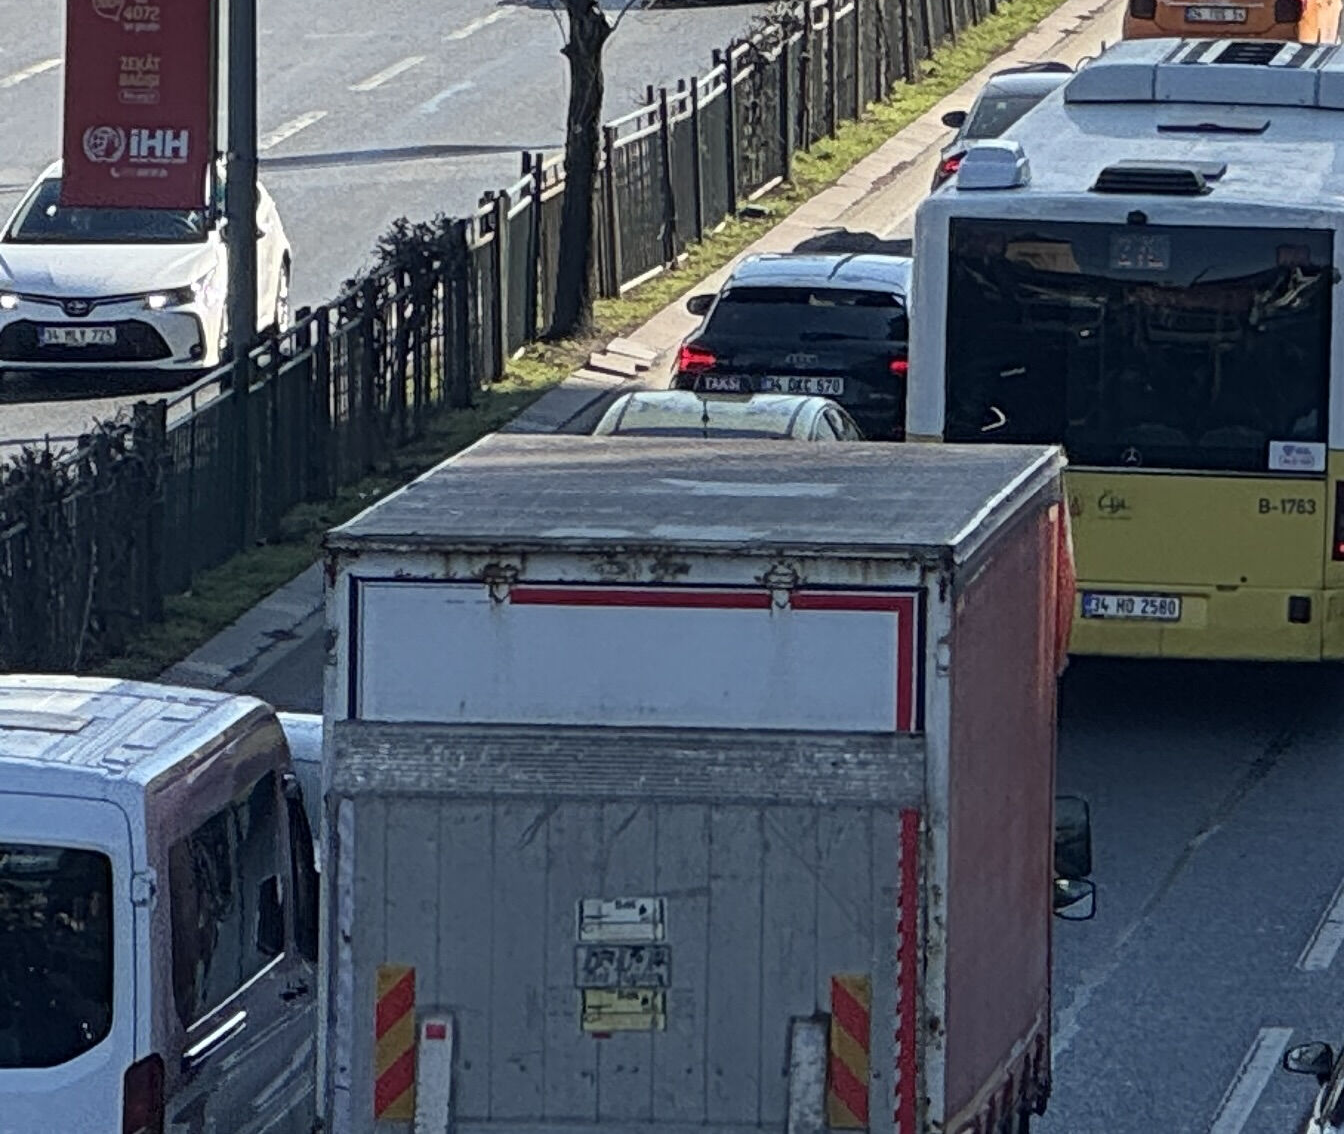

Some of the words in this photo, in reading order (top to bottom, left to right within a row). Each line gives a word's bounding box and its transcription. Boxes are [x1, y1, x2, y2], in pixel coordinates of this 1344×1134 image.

[123, 7, 159, 21] 4072
[1259, 499, 1316, 514] B-1763
[1092, 598, 1108, 611] 34
[1141, 600, 1176, 615] 2580
